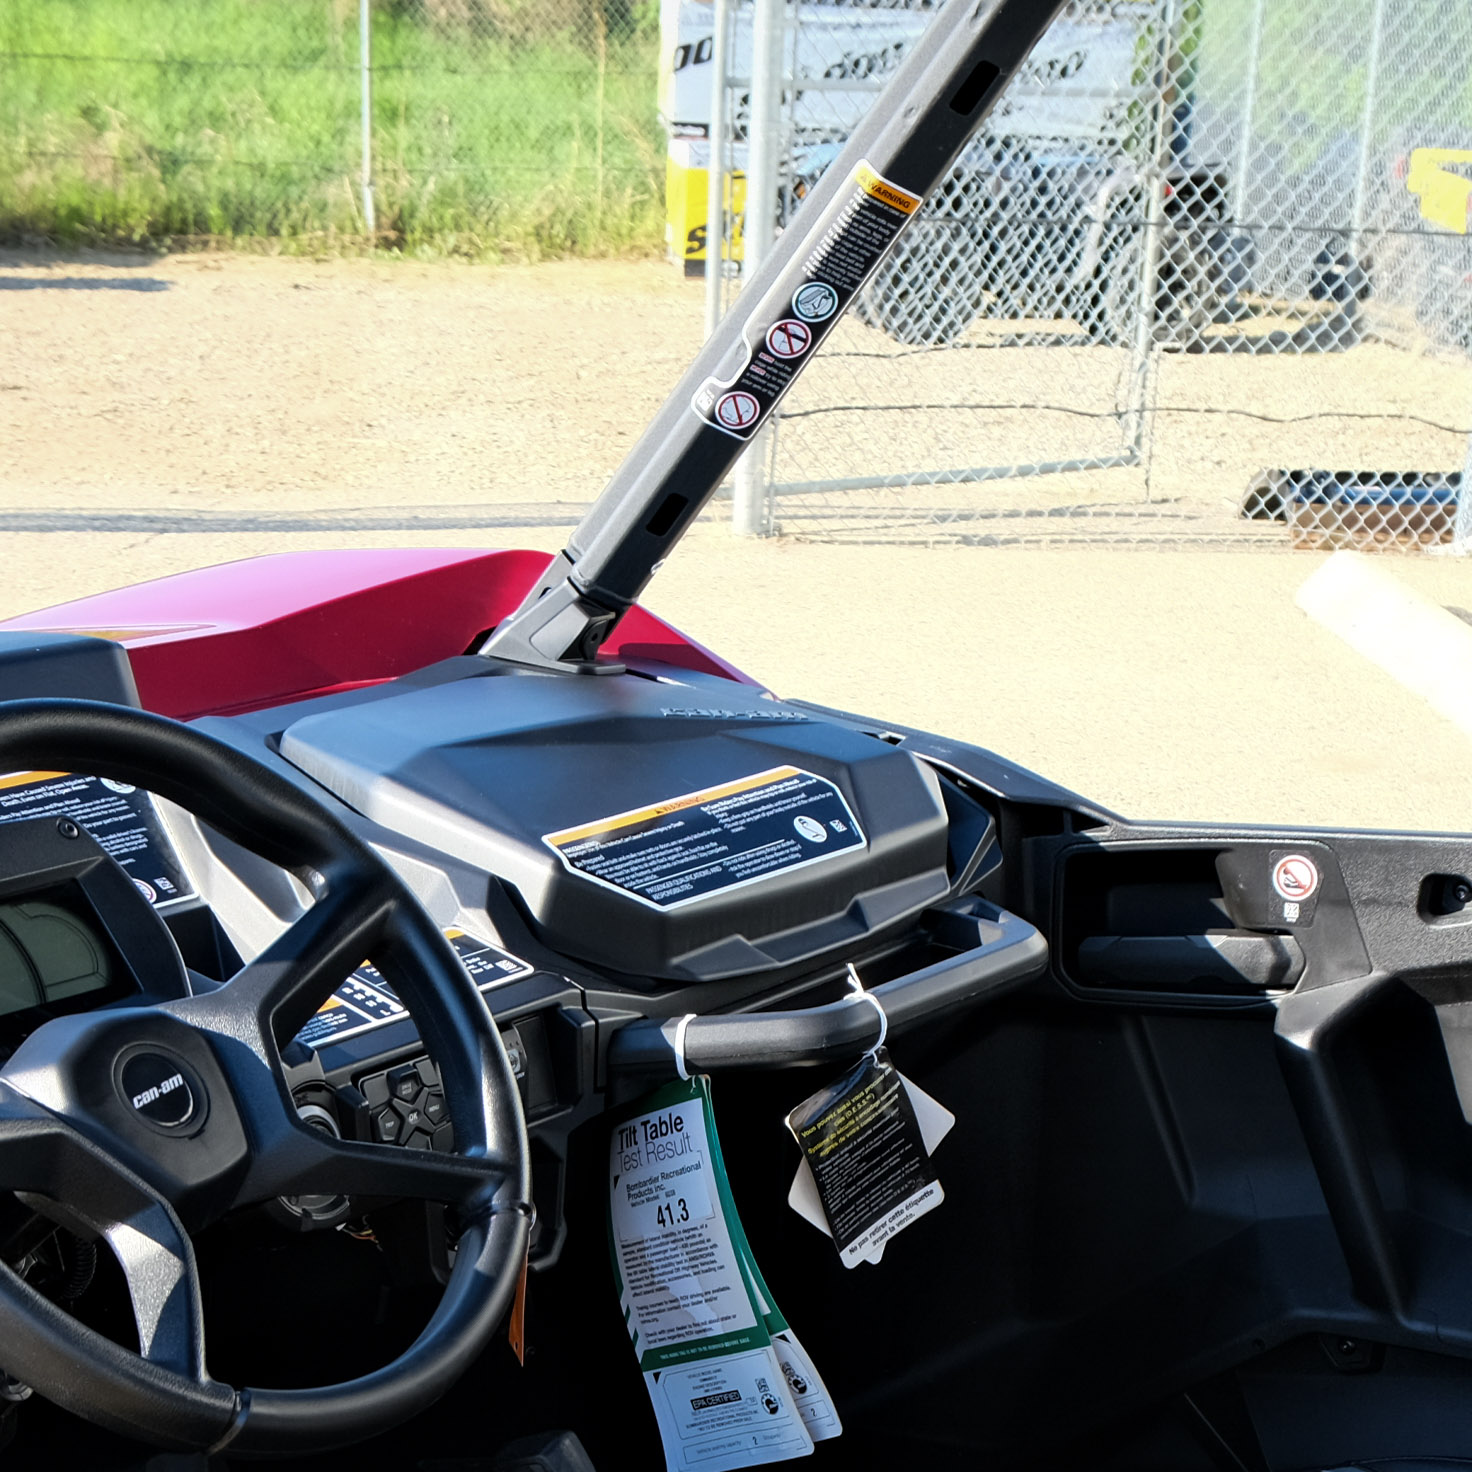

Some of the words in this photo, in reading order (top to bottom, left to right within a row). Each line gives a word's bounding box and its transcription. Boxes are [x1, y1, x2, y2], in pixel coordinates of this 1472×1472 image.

[868, 180, 910, 210] WARNING
[133, 1073, 183, 1110] can-am
[409, 1112, 418, 1121] OK
[618, 1125, 638, 1151] Tilt
[641, 1112, 684, 1142] Table
[801, 1126, 816, 1138] Vous
[617, 1147, 643, 1173] Test
[646, 1132, 693, 1165] Result
[626, 1176, 659, 1193] Bombardier
[660, 1161, 701, 1179] Recreational
[627, 1187, 653, 1201] Products
[657, 1198, 690, 1228] 41.3
[849, 1245, 858, 1255] Ne
[858, 1237, 869, 1249] pas
[869, 1220, 888, 1239] retirer
[888, 1208, 905, 1223] cette
[905, 1189, 934, 1213] étiquette
[872, 1231, 889, 1247] avant
[889, 1225, 896, 1233] la
[692, 1397, 707, 1409] EPA
[707, 1391, 740, 1407] CERTIFIED
[811, 1408, 817, 1417] 2
[752, 1436, 759, 1445] 2
